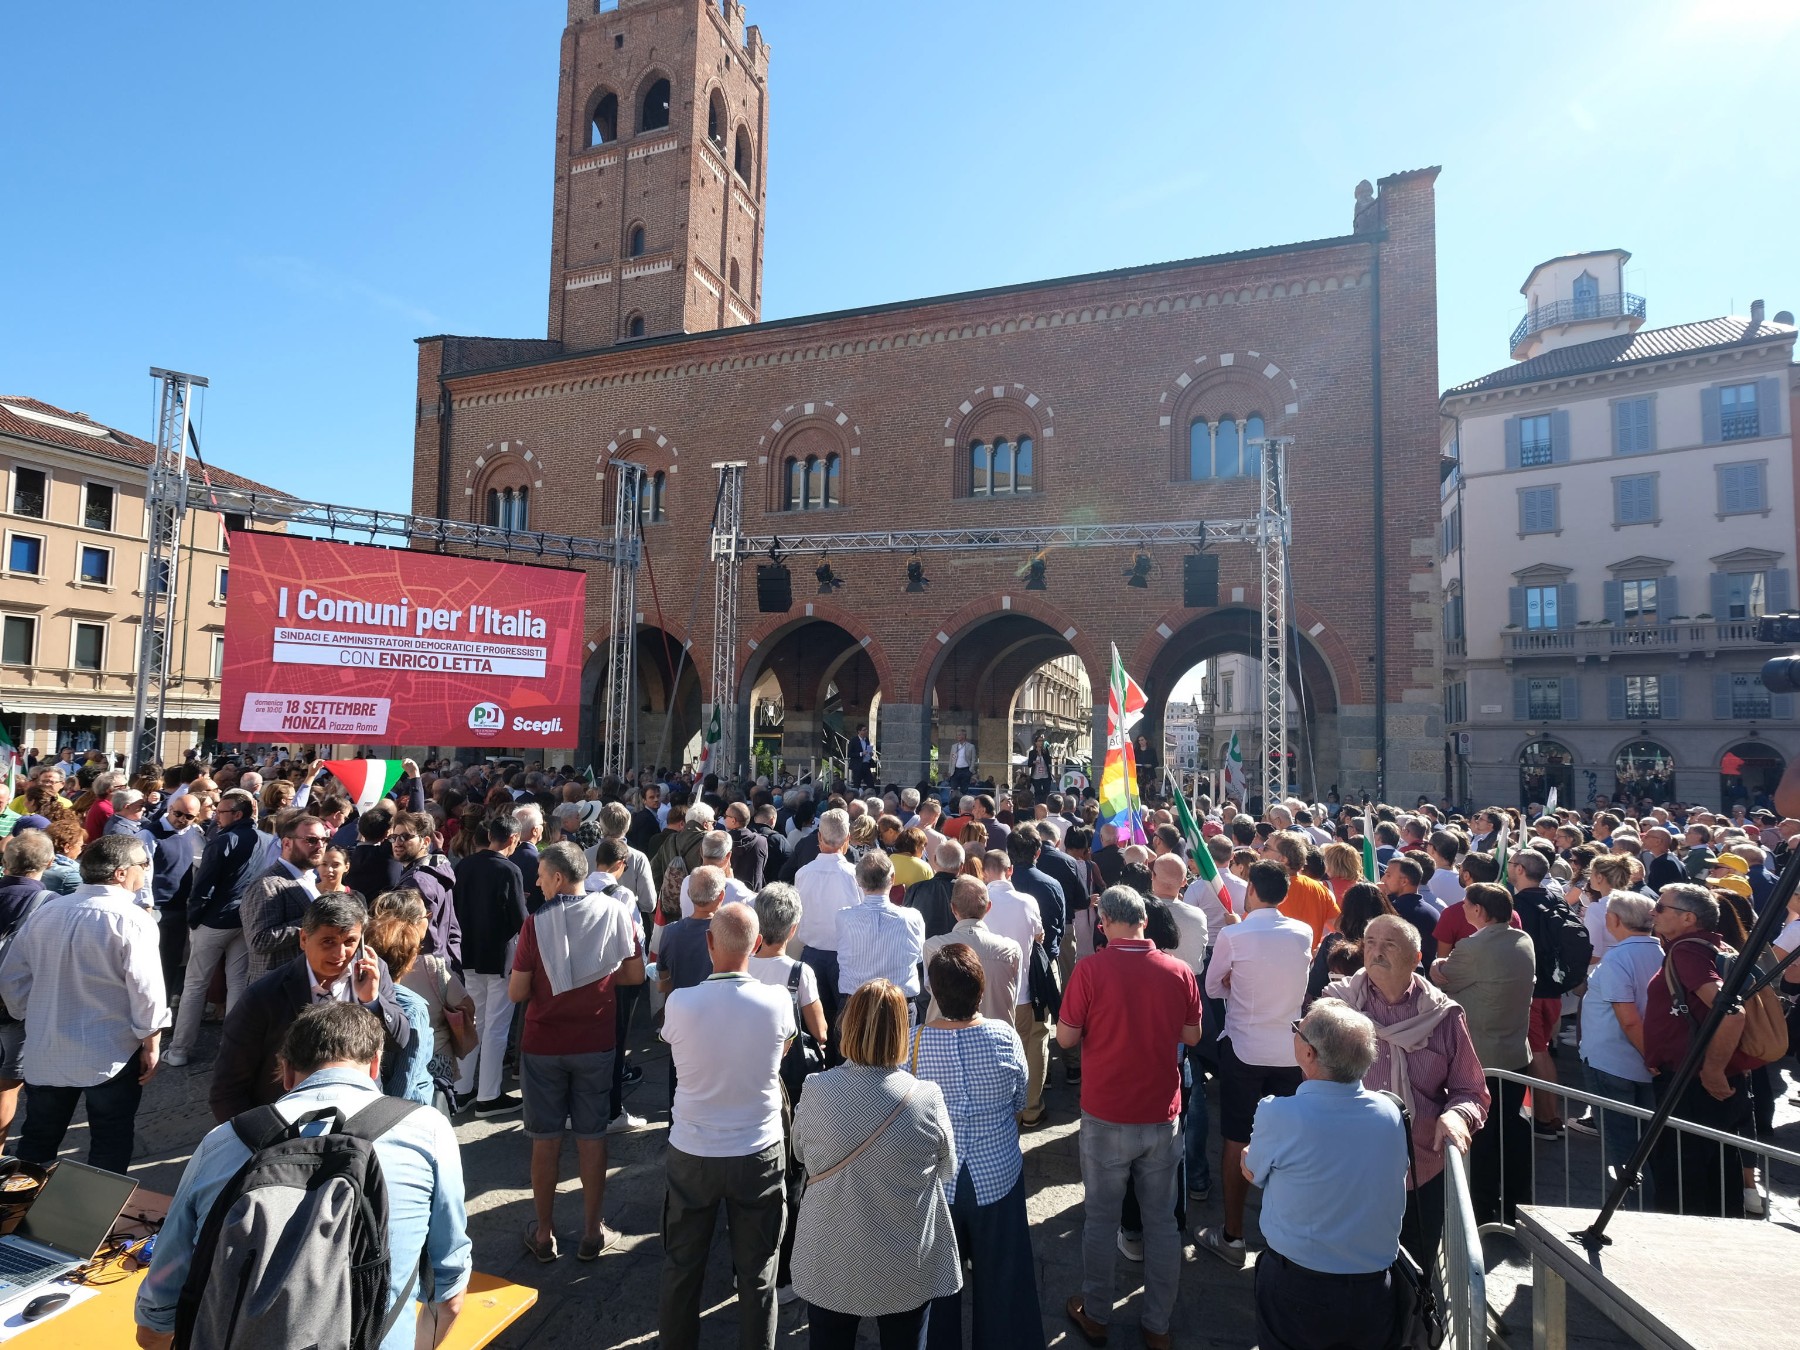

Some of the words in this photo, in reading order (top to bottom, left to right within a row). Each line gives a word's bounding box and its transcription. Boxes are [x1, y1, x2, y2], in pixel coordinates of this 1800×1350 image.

[279, 587, 288, 617] I
[298, 589, 408, 627] Comuni
[416, 607, 462, 635] per
[280, 631, 321, 640] SINDACI
[324, 634, 330, 642] E
[332, 635, 413, 648] AMMINISTRATORI
[415, 641, 474, 652] DEMOCRATICI
[483, 646, 542, 657] PROGRESSISTI
[340, 650, 375, 665] CON
[379, 653, 439, 669] ENRICO
[442, 657, 492, 672] LETTA
[286, 700, 299, 714] 18
[303, 701, 378, 716] SETTEMBRE
[474, 706, 500, 723] PD
[282, 716, 326, 730] MONZA
[329, 722, 354, 731] Piazza
[356, 723, 378, 731] Roma
[512, 716, 564, 735] Scegli.
